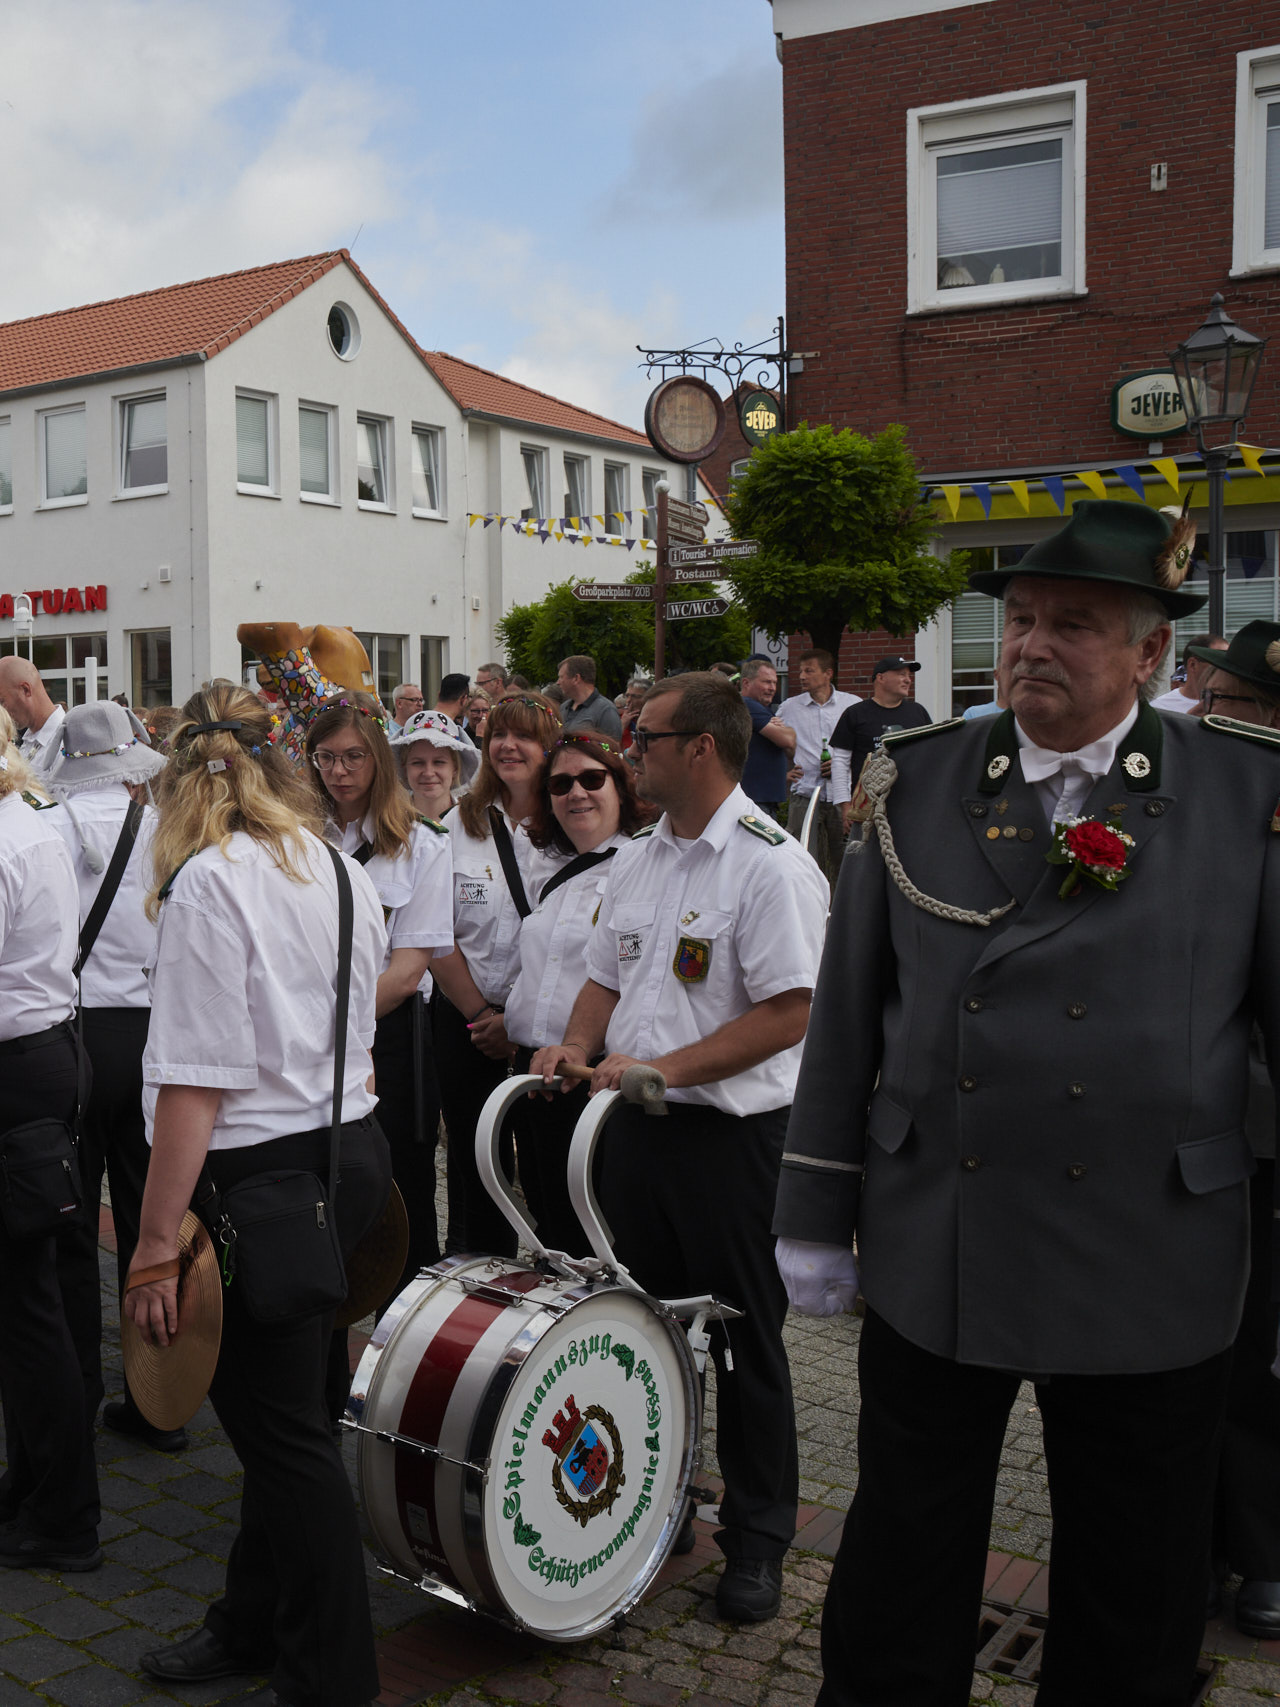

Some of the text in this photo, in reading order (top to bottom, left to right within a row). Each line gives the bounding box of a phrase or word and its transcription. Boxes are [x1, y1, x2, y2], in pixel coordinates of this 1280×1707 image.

[1131, 391, 1183, 417] JEVER
[746, 410, 777, 430] JEVER
[681, 549, 706, 560] Tourist
[713, 544, 757, 557] Information
[675, 568, 720, 580] Postamt
[22, 585, 107, 617] TUAN
[671, 601, 711, 617] WC/WC
[503, 1333, 612, 1520] Spielmannszug
[528, 1454, 659, 1588] Schützencompagnie
